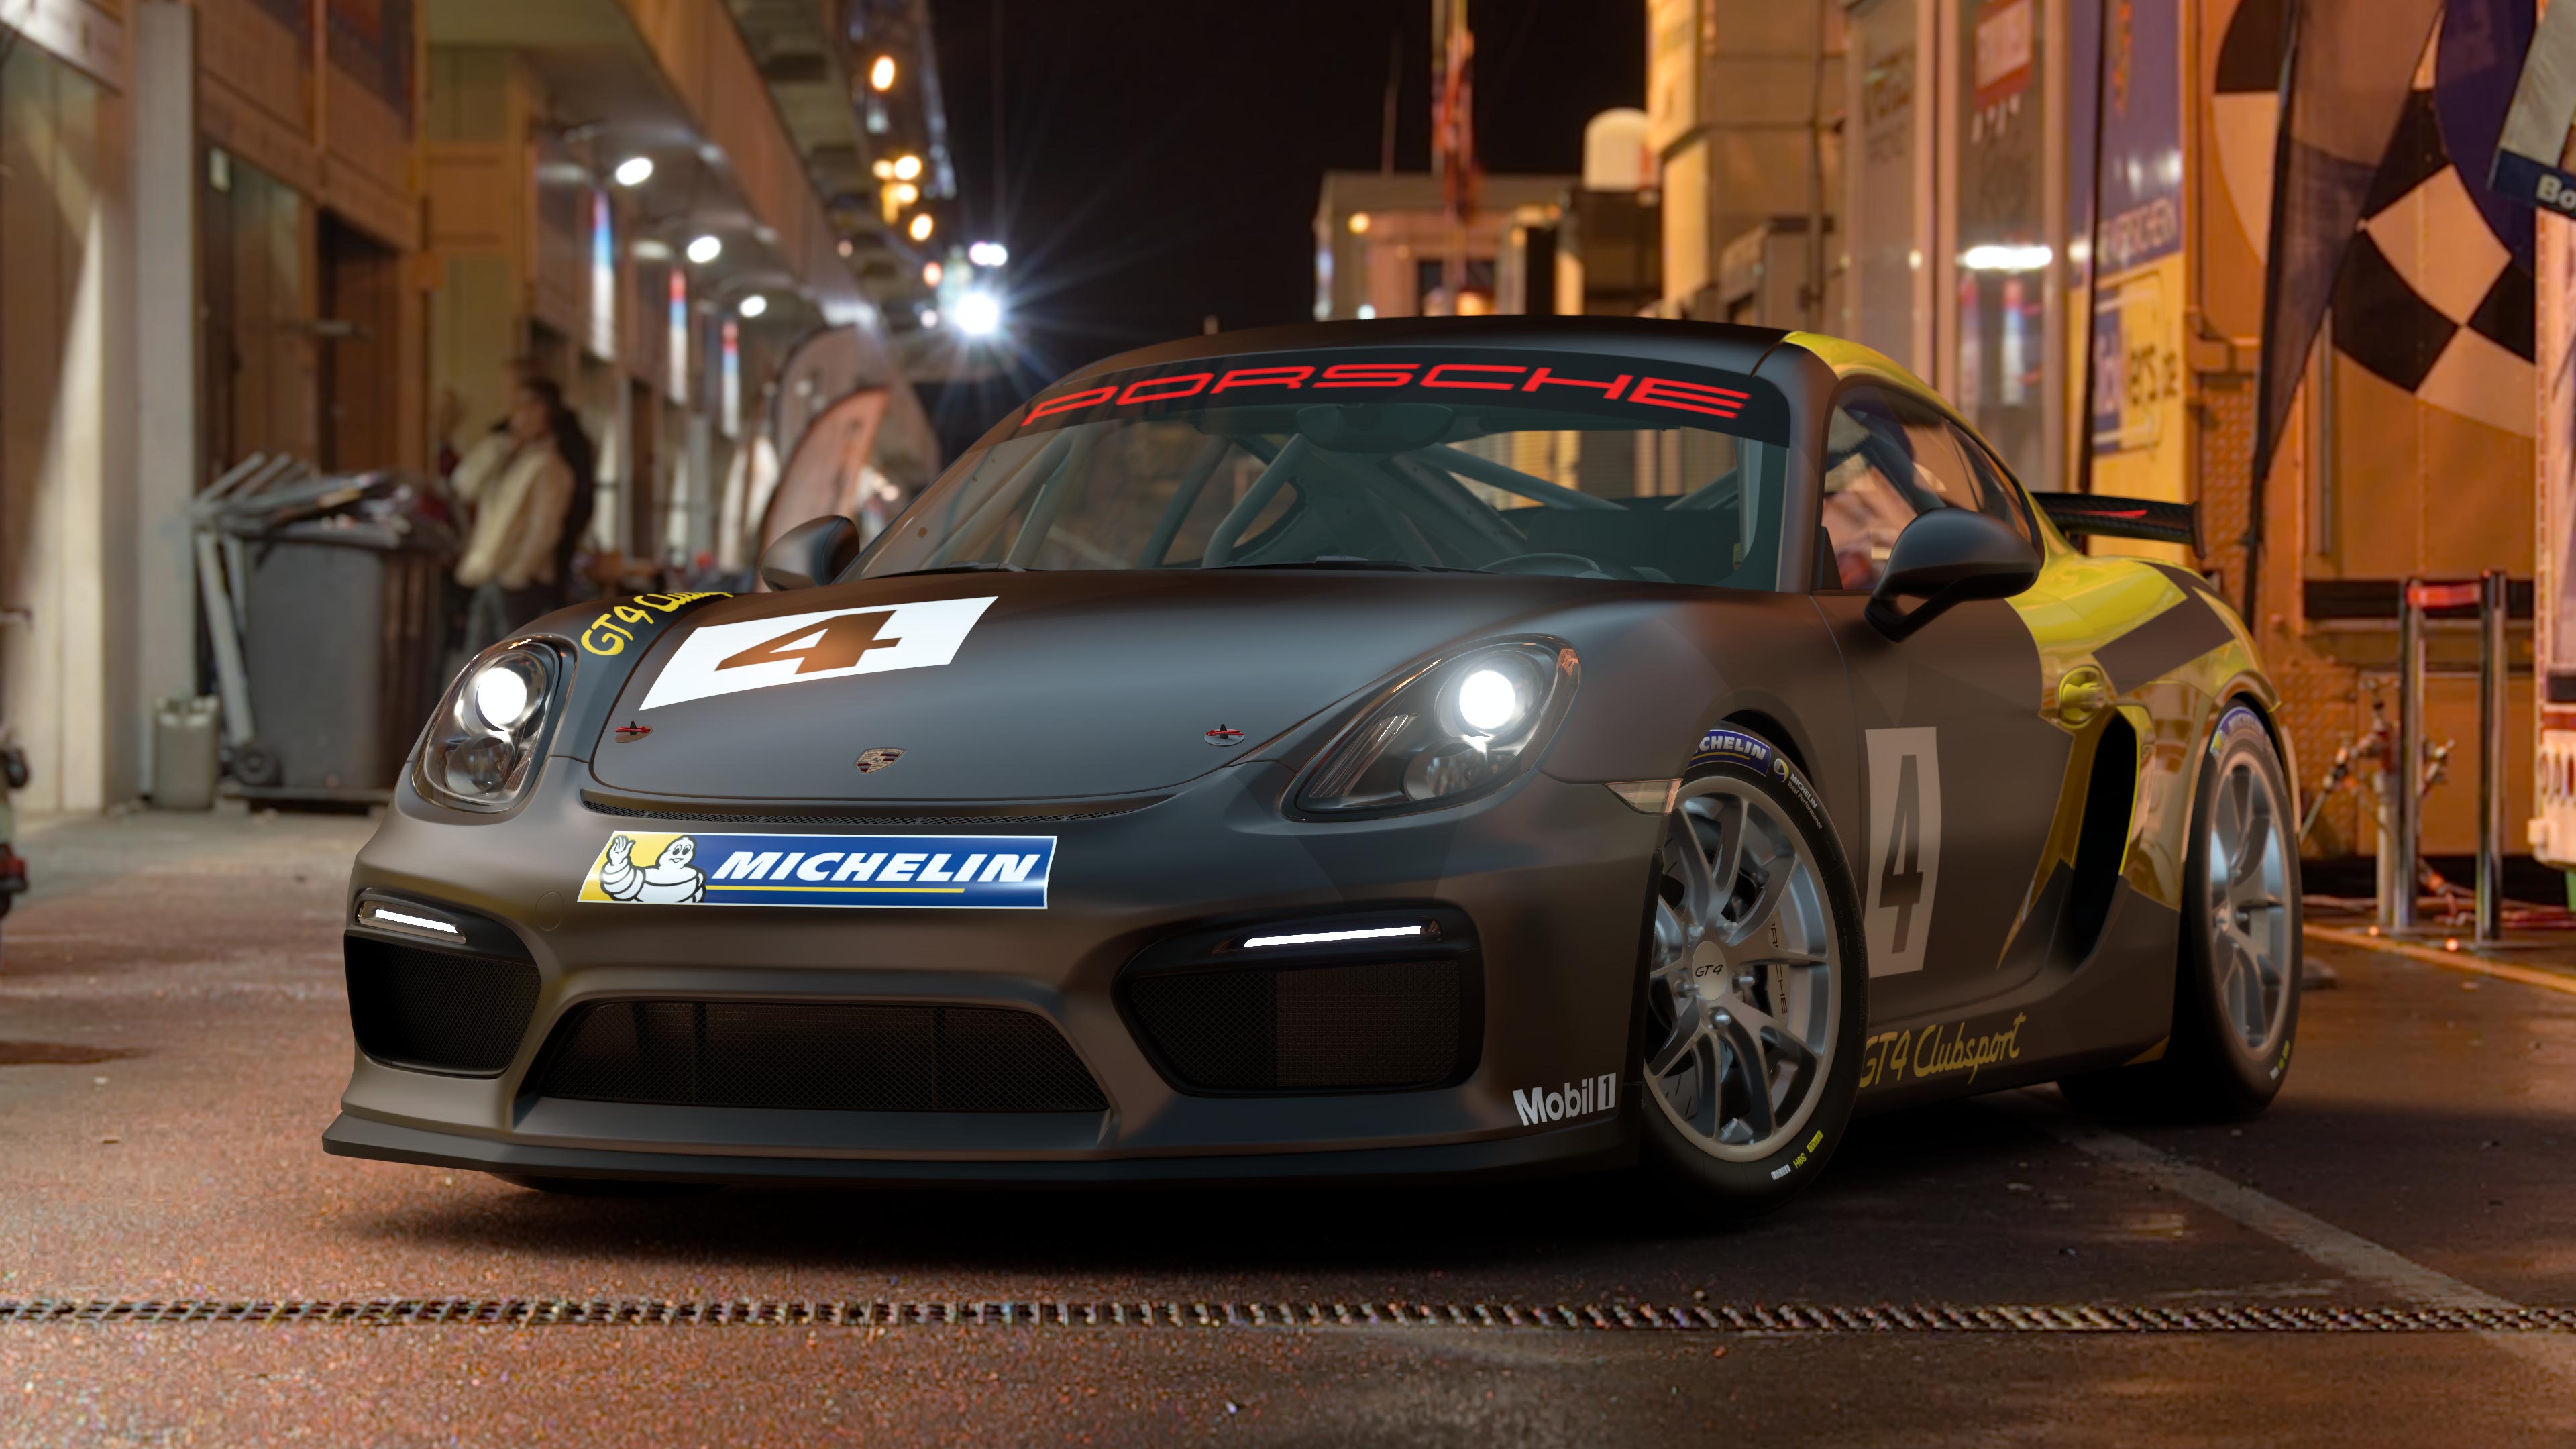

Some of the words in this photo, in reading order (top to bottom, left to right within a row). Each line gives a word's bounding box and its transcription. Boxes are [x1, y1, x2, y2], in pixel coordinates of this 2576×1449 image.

[1021, 363, 1751, 427] PORSCHE
[581, 606, 654, 655] GT4
[714, 610, 902, 675] 4
[1695, 735, 1766, 760] CHELIN
[1790, 773, 1817, 809] MICHELIN
[1797, 793, 1823, 830] Performance
[712, 851, 1041, 883] MICHELIN
[1878, 754, 1923, 955] 4
[1695, 964, 1723, 977] GT4
[1858, 1029, 1911, 1088] GT4
[1913, 1012, 2027, 1085] Clubsport
[1513, 1077, 1593, 1126] Mobil
[1792, 1152, 1807, 1169] H6S
